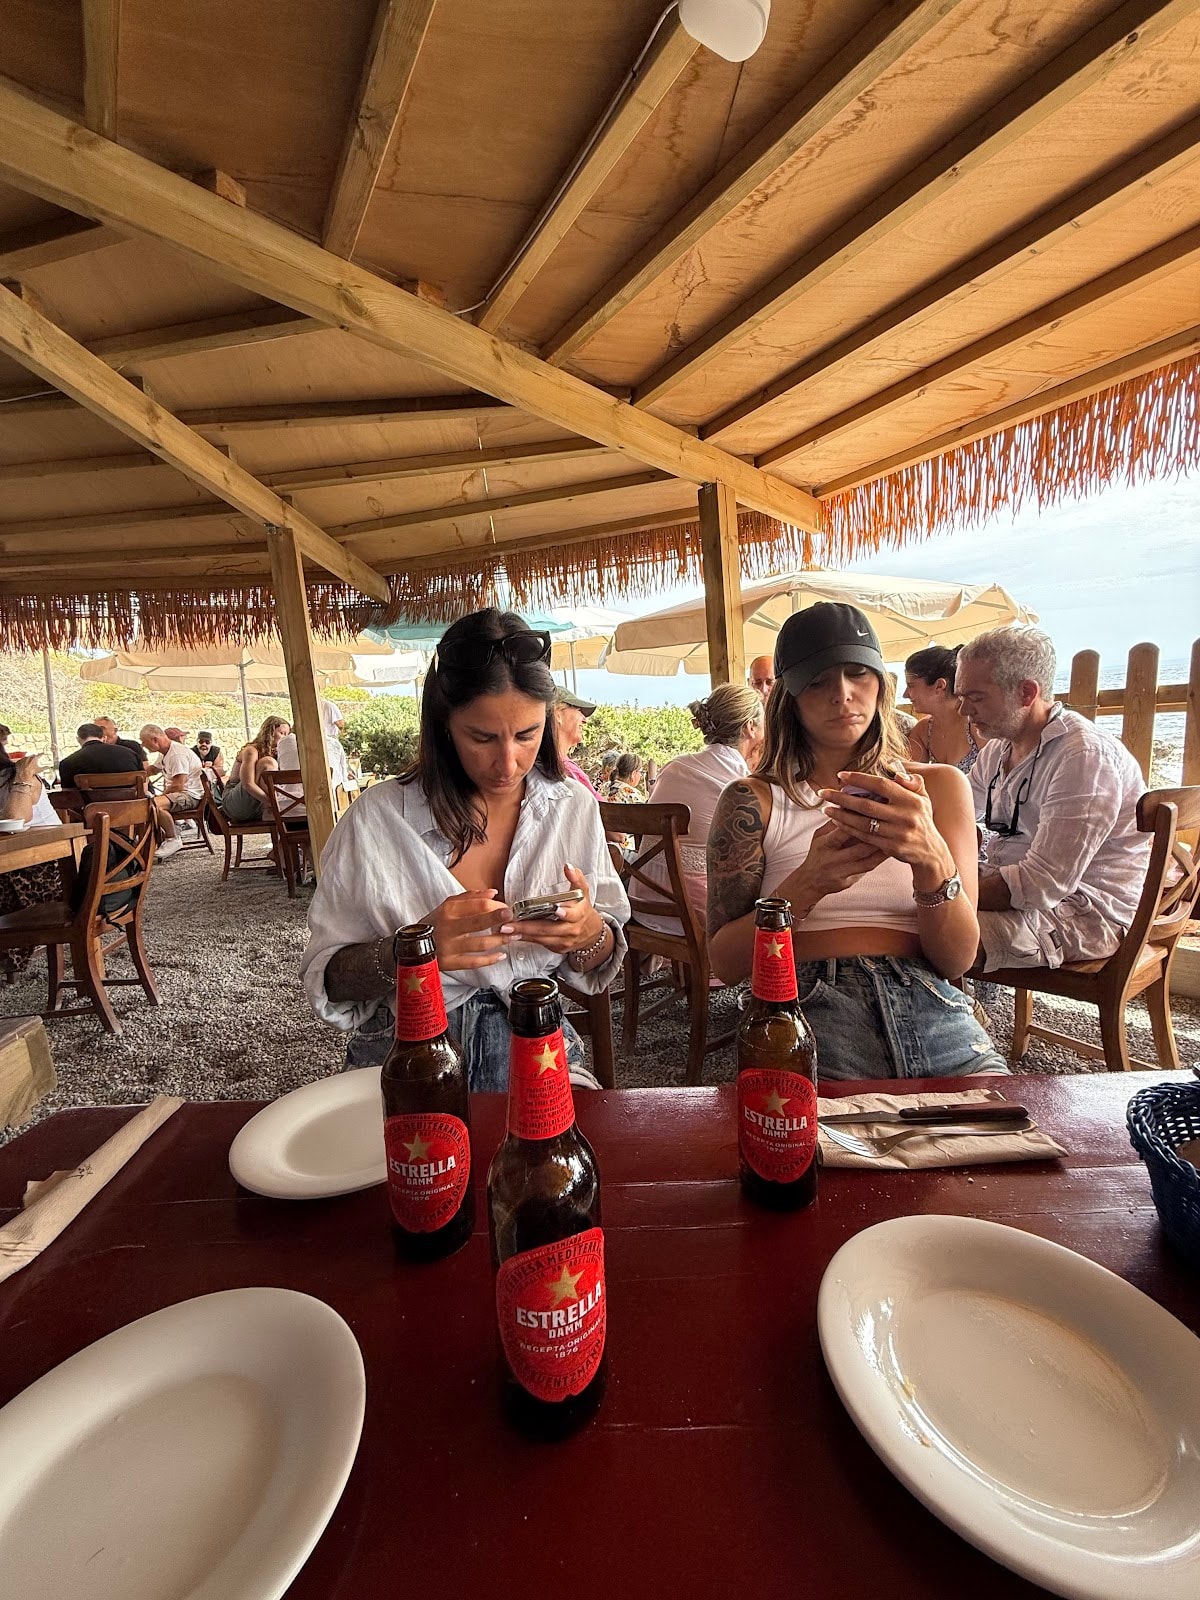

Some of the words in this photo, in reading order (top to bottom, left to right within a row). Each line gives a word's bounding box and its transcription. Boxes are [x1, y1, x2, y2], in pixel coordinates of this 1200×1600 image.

[744, 1105, 808, 1131] ESTRELLA
[762, 1127, 788, 1138] DAMM
[775, 1141, 806, 1149] ORIGINAL
[389, 1155, 457, 1178] ESTRELLA
[406, 1177, 433, 1186] DAMM
[420, 1182, 455, 1196] ORIGINAL
[516, 1280, 602, 1330] ESTRELLA
[548, 1320, 583, 1339] DAMM
[555, 1346, 579, 1359] 1876
